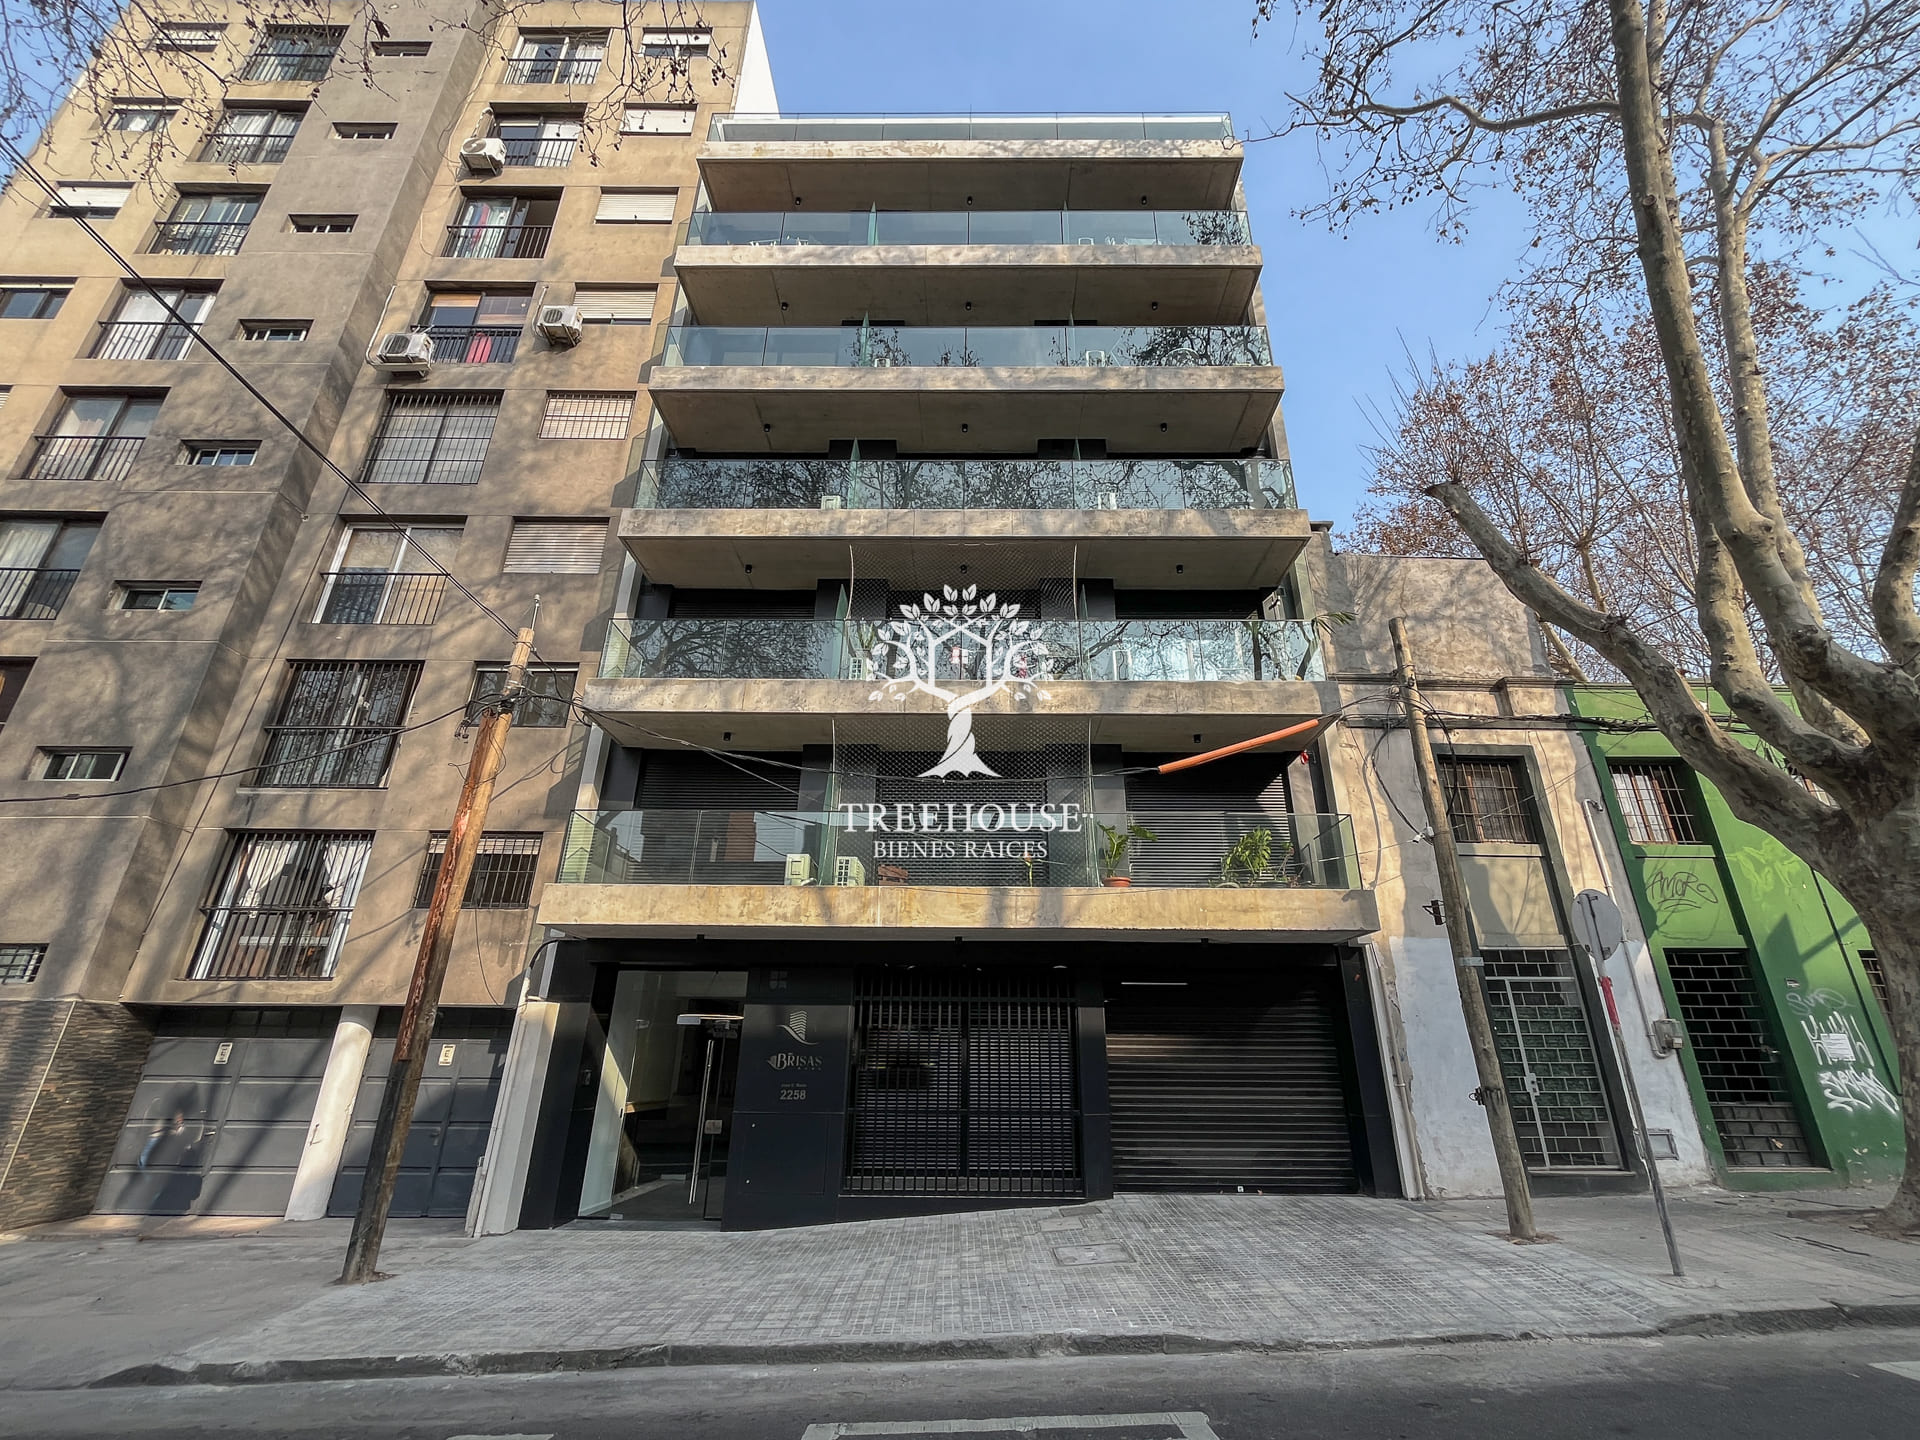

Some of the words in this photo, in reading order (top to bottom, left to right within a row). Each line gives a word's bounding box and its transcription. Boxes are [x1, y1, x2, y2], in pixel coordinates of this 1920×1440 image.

[1646, 870, 1719, 904] AMOR
[777, 1053, 822, 1069] BRISAS
[780, 1090, 806, 1100] 2258
